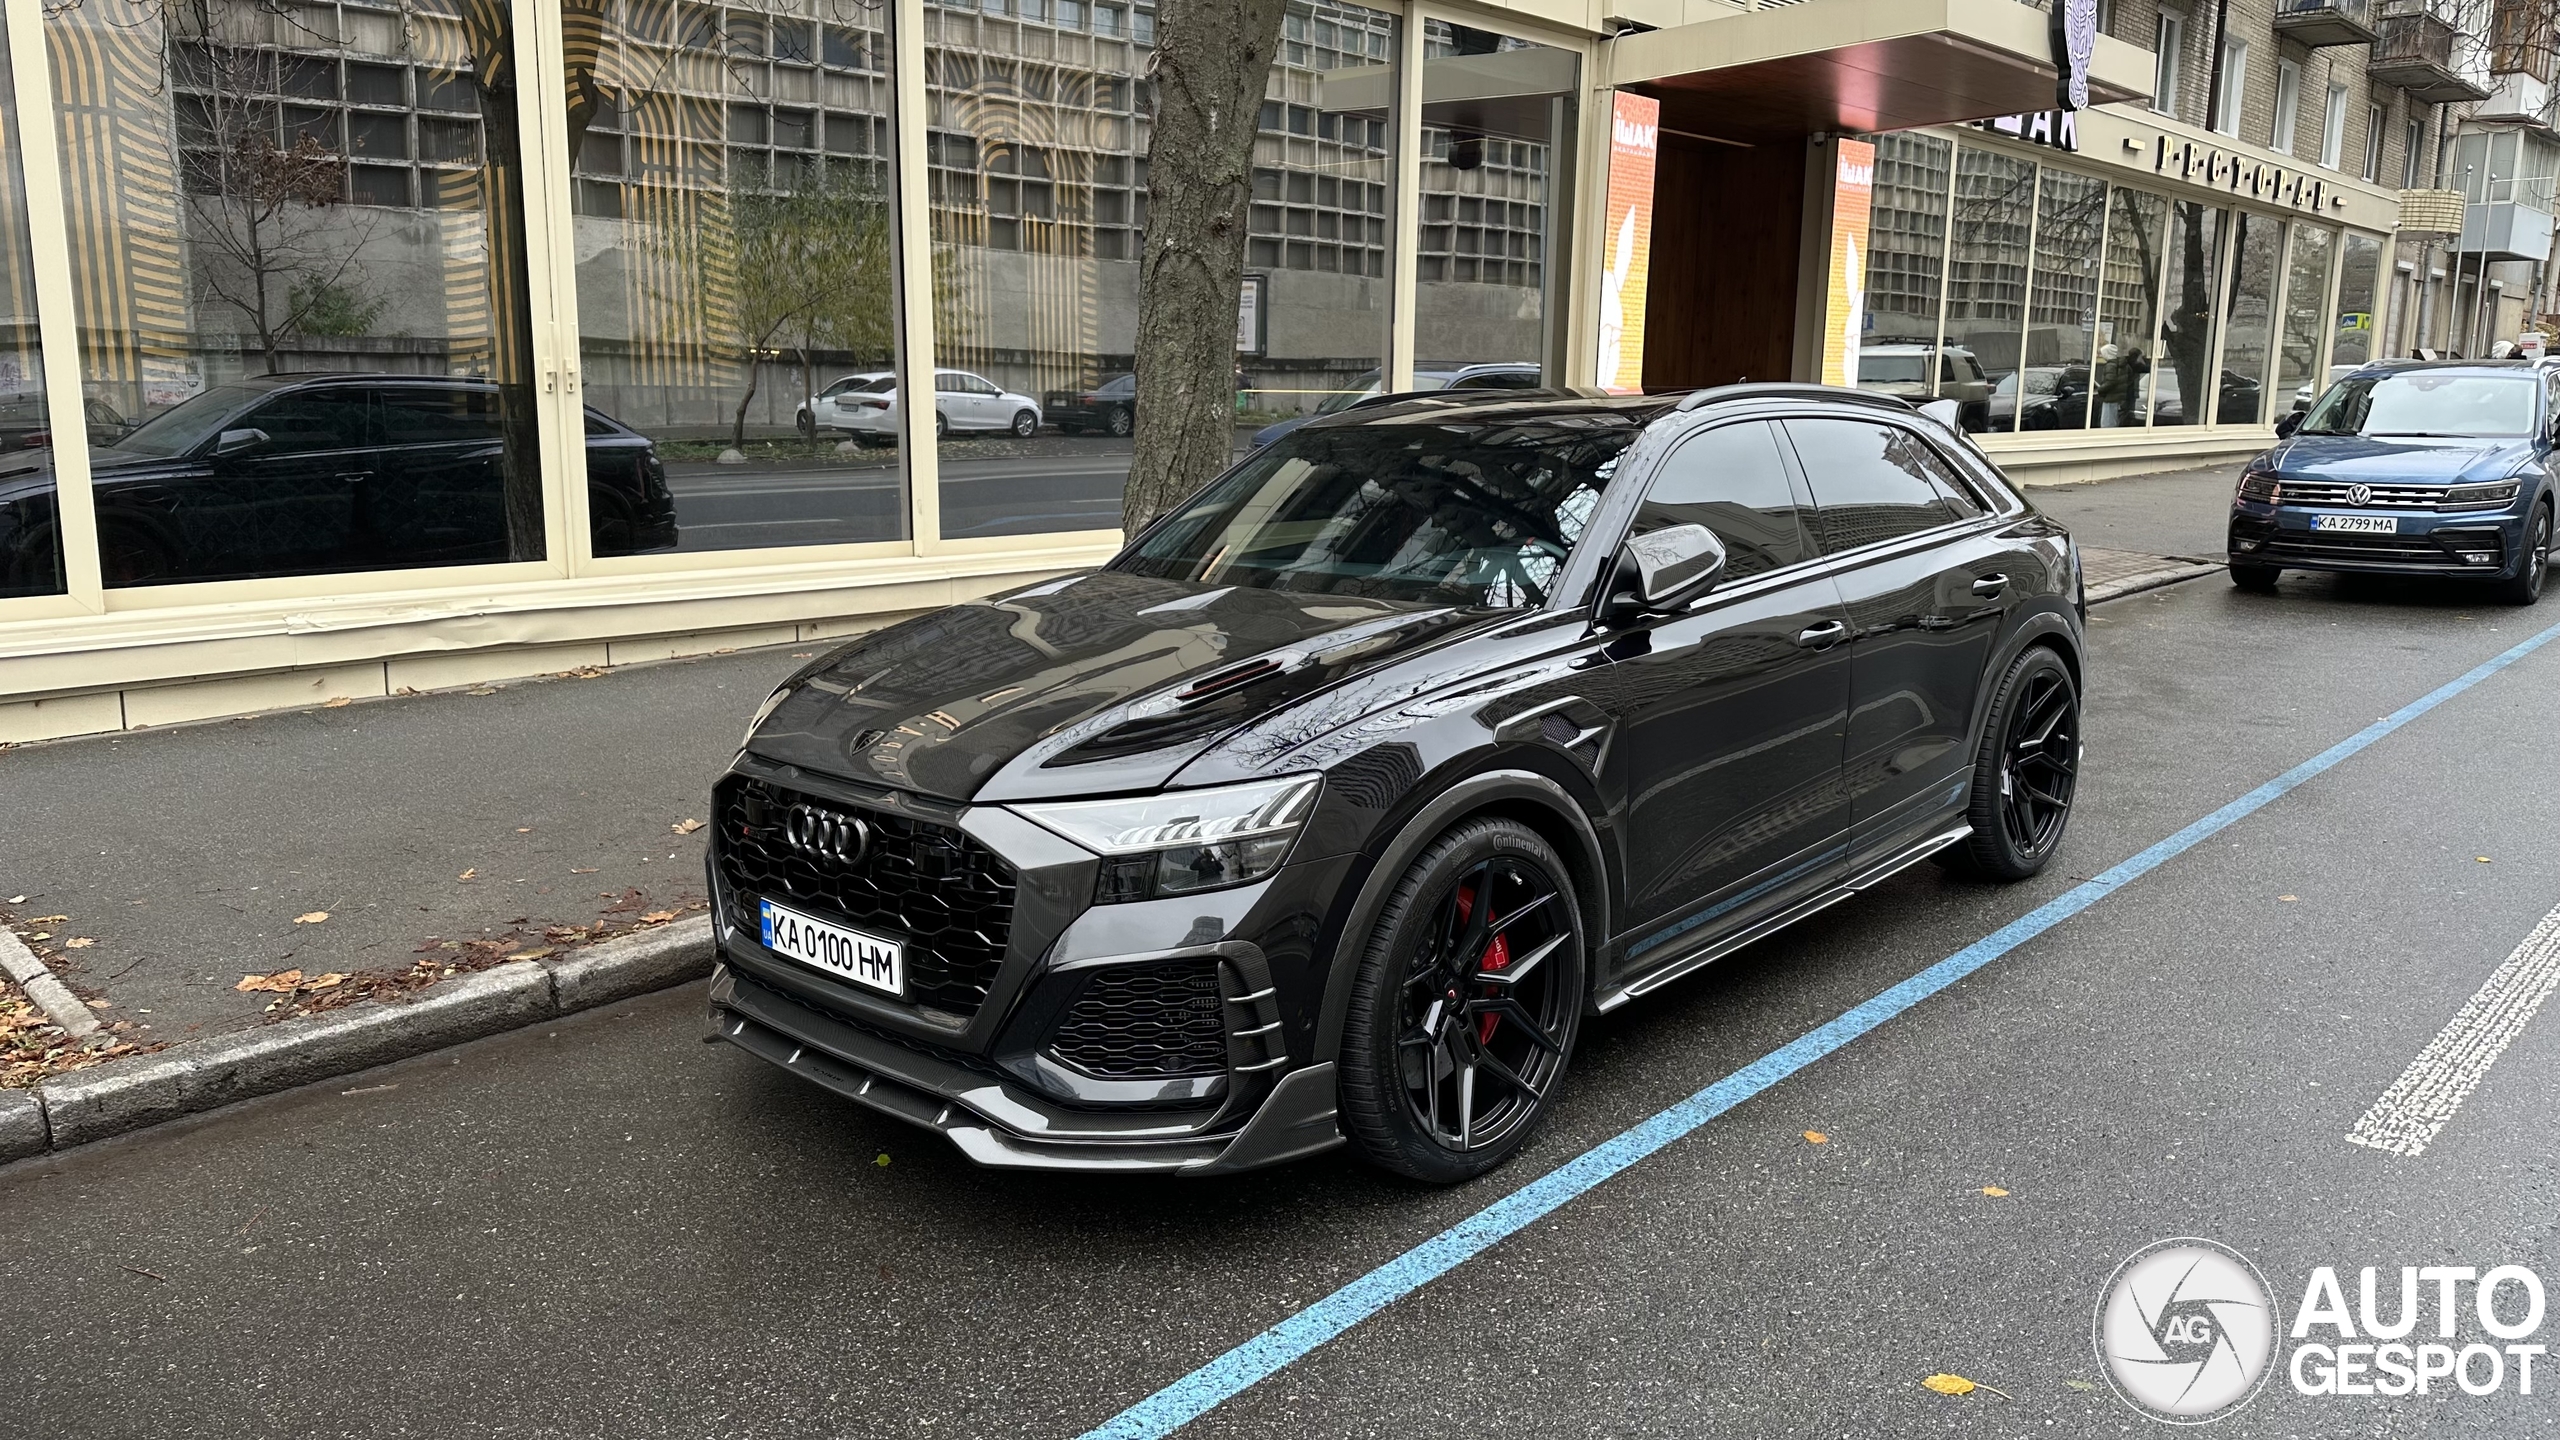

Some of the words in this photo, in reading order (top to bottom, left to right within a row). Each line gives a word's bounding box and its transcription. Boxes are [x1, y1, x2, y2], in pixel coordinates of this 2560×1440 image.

[2318, 517, 2337, 528] KA
[2340, 518, 2370, 530] 2799
[2373, 519, 2393, 531] MA
[1493, 834, 1543, 858] Continental
[763, 929, 772, 940] UA
[773, 912, 801, 954] KA
[805, 925, 853, 971] 0100
[858, 941, 893, 985] HM
